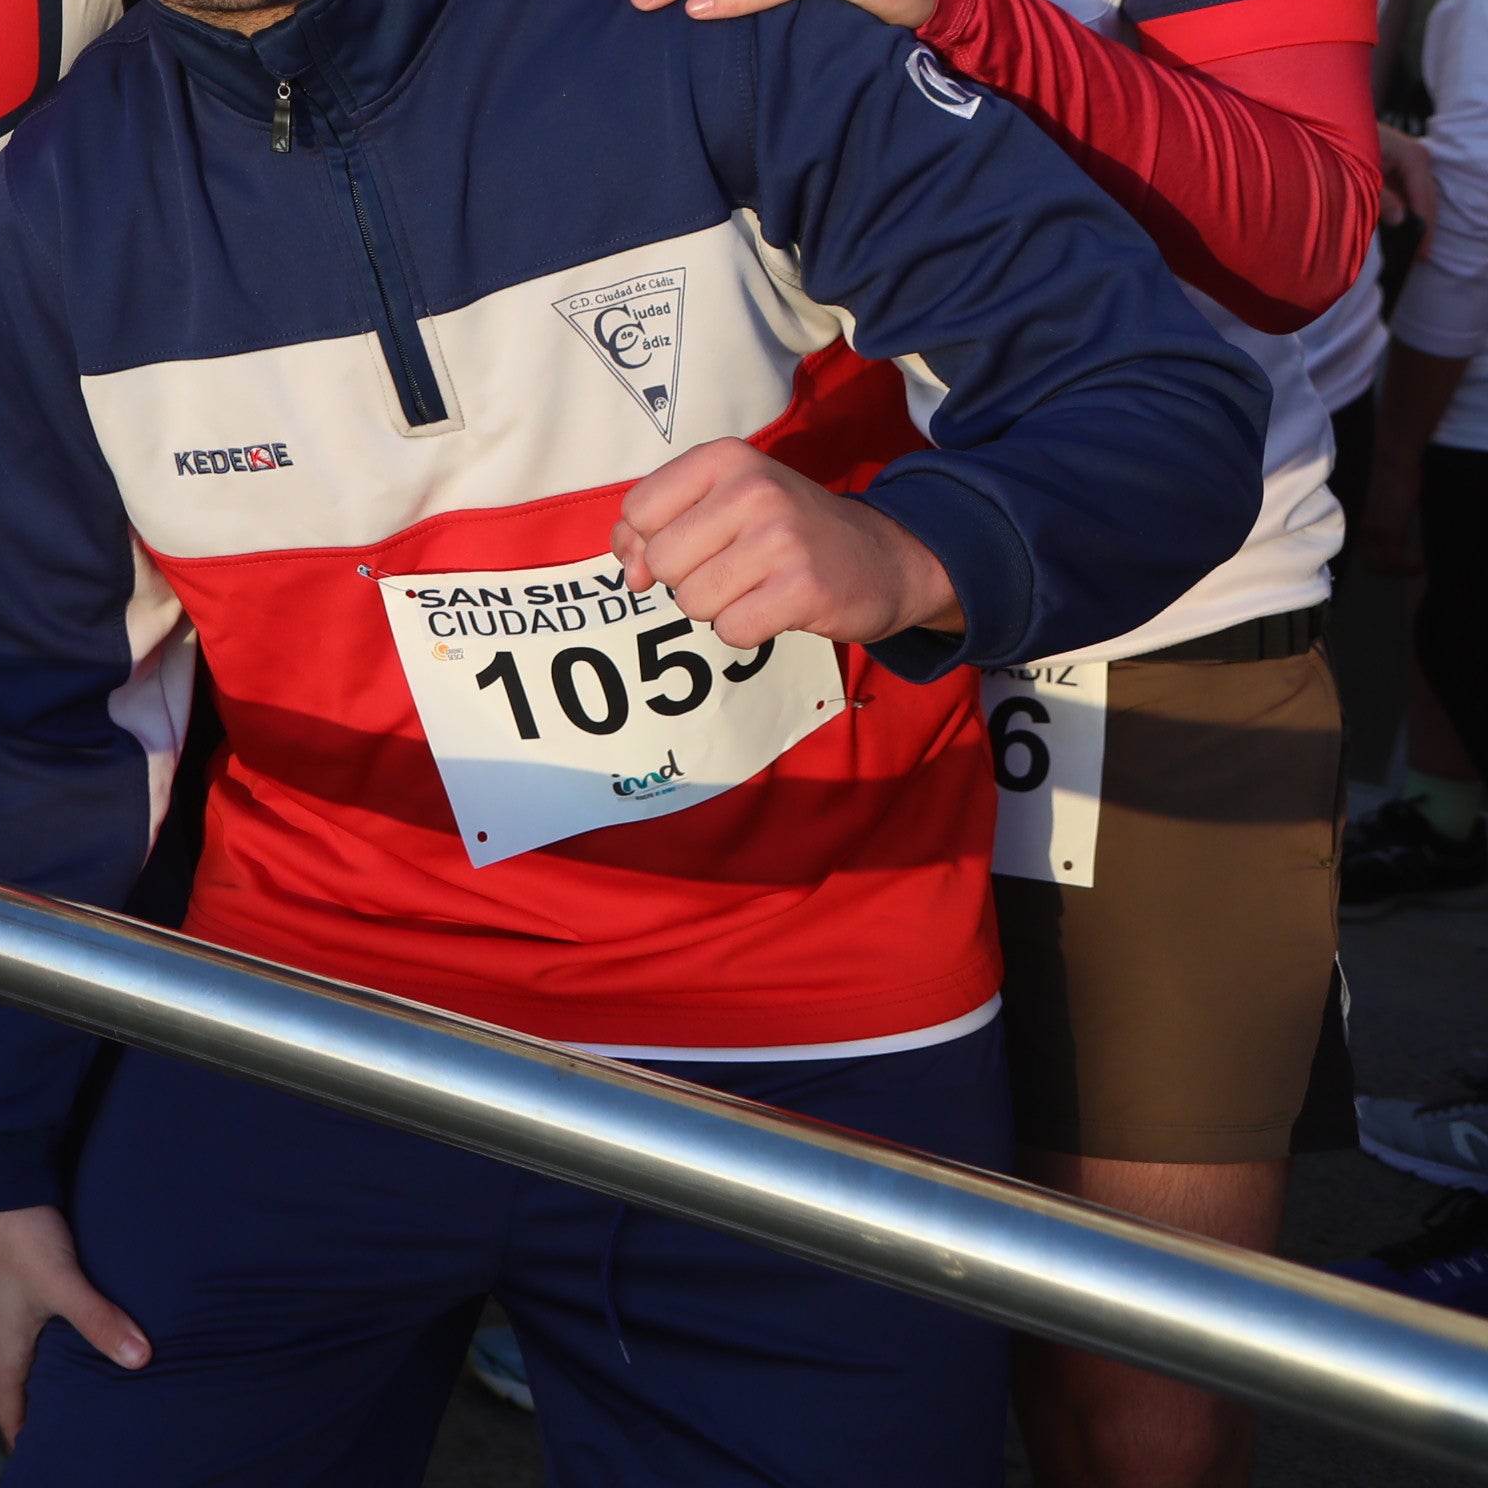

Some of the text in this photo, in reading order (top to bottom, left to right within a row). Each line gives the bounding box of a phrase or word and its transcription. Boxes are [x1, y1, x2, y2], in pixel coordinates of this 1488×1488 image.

[569, 276, 675, 310] C.D. Ciudad de Cádiz
[428, 601, 586, 638] CIUDAD
[597, 591, 657, 624] DE
